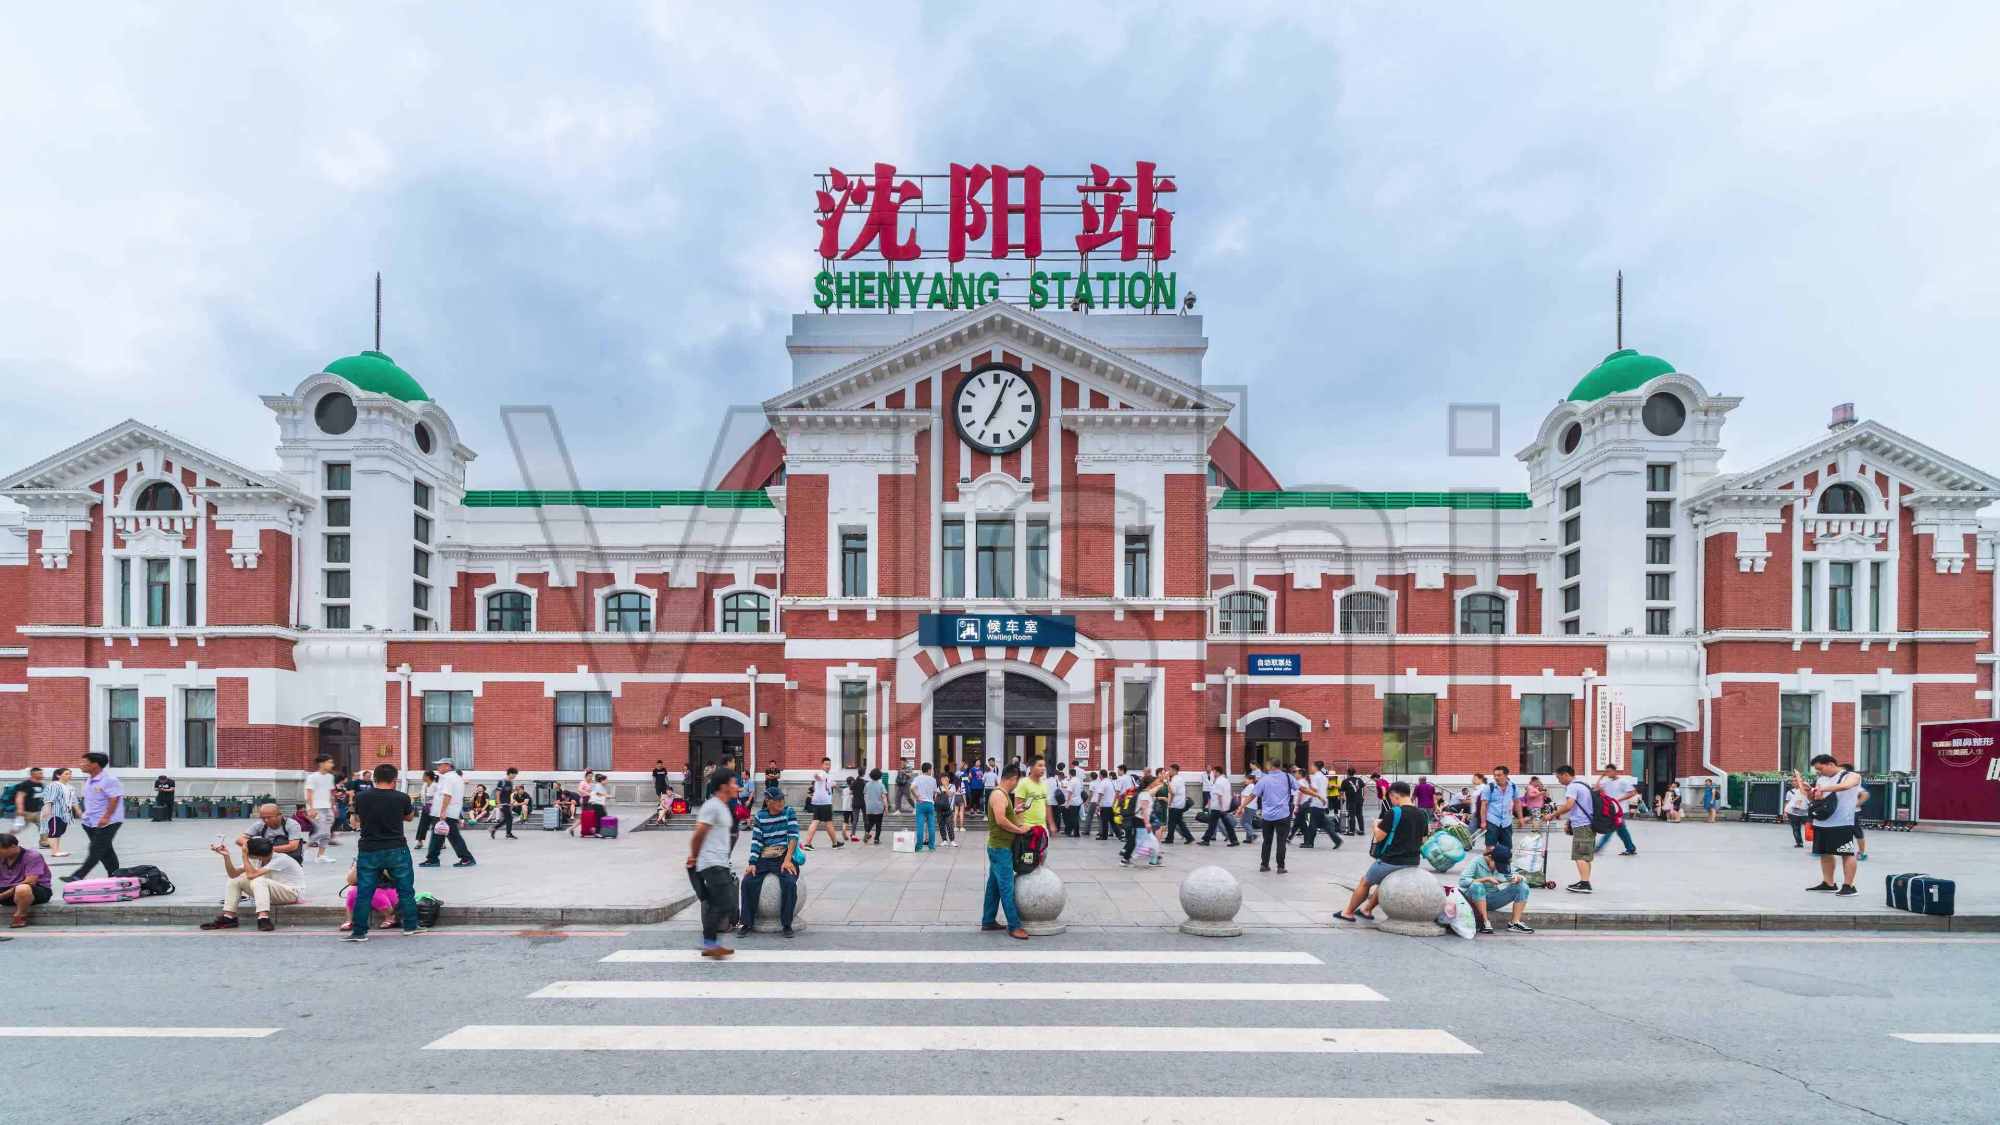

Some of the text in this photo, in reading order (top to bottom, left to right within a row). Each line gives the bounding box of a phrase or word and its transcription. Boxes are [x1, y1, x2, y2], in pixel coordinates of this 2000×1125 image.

[816, 161, 1177, 262] 沈阳站
[813, 271, 1177, 309] SHENYANG STATION
[987, 619, 1038, 633] 候车室
